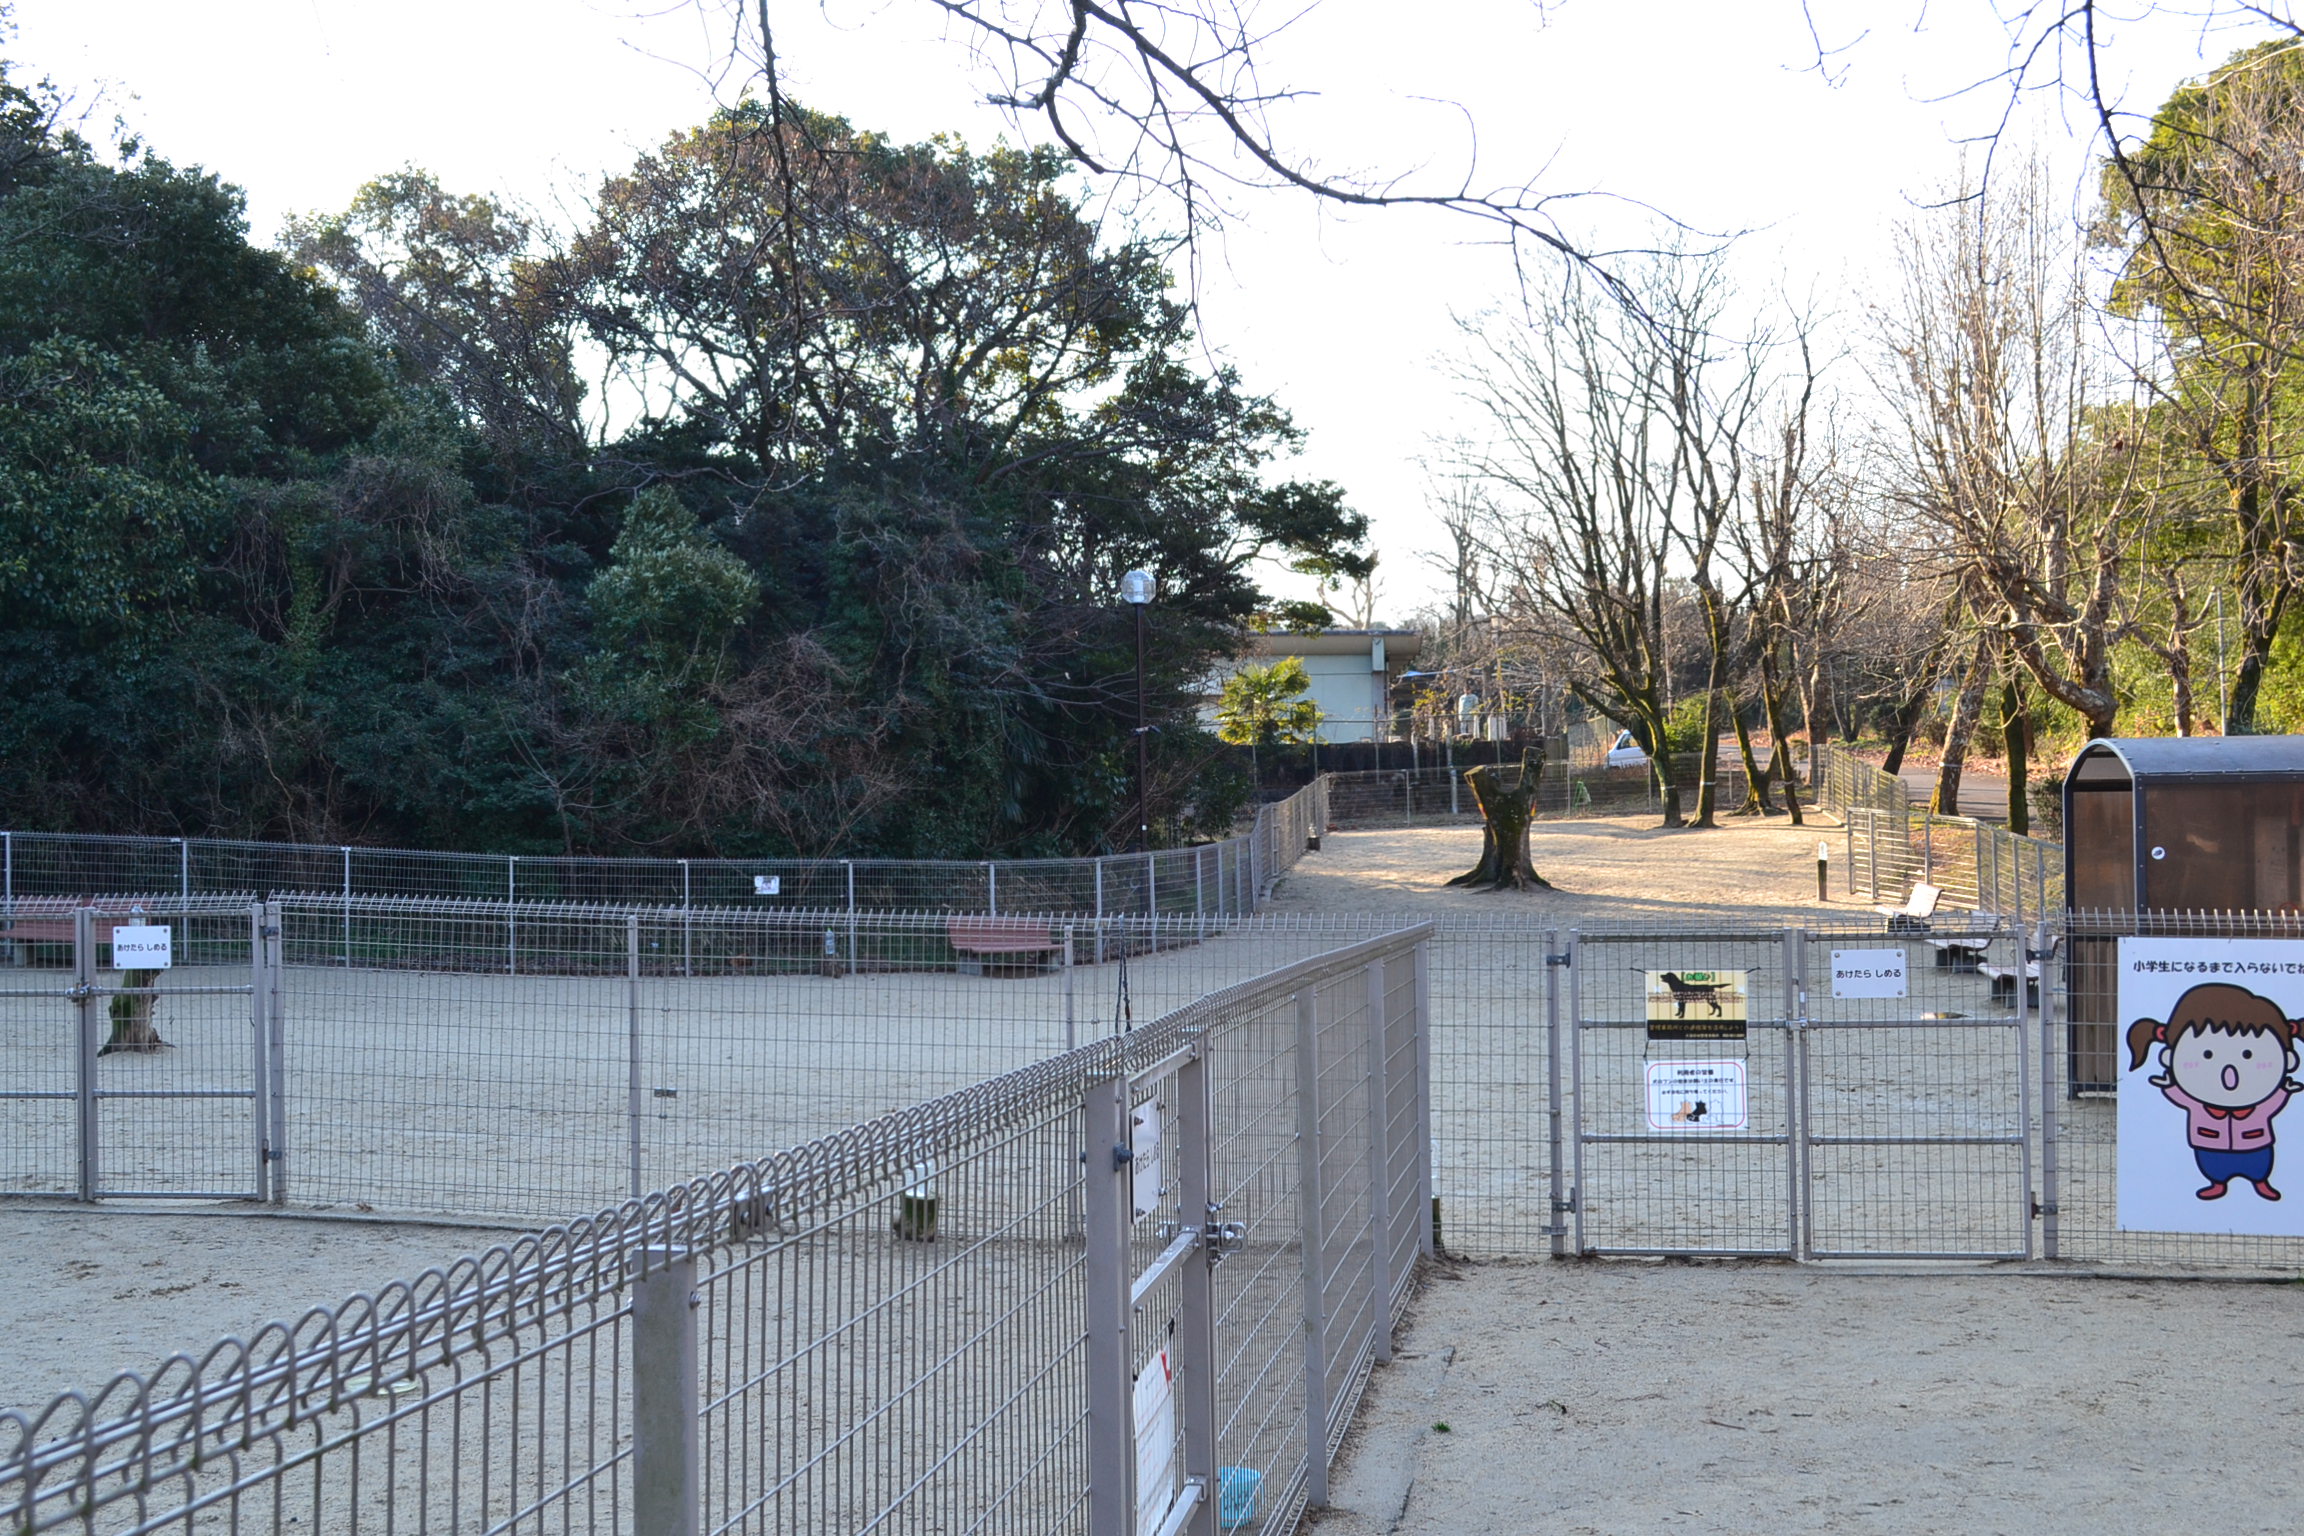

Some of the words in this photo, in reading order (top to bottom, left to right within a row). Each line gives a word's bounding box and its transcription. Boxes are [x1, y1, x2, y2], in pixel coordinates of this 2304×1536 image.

[117, 944, 144, 952] あけたら
[147, 943, 167, 952] しめる
[1836, 969, 1872, 979] あけたら
[1875, 968, 1902, 978] しめる
